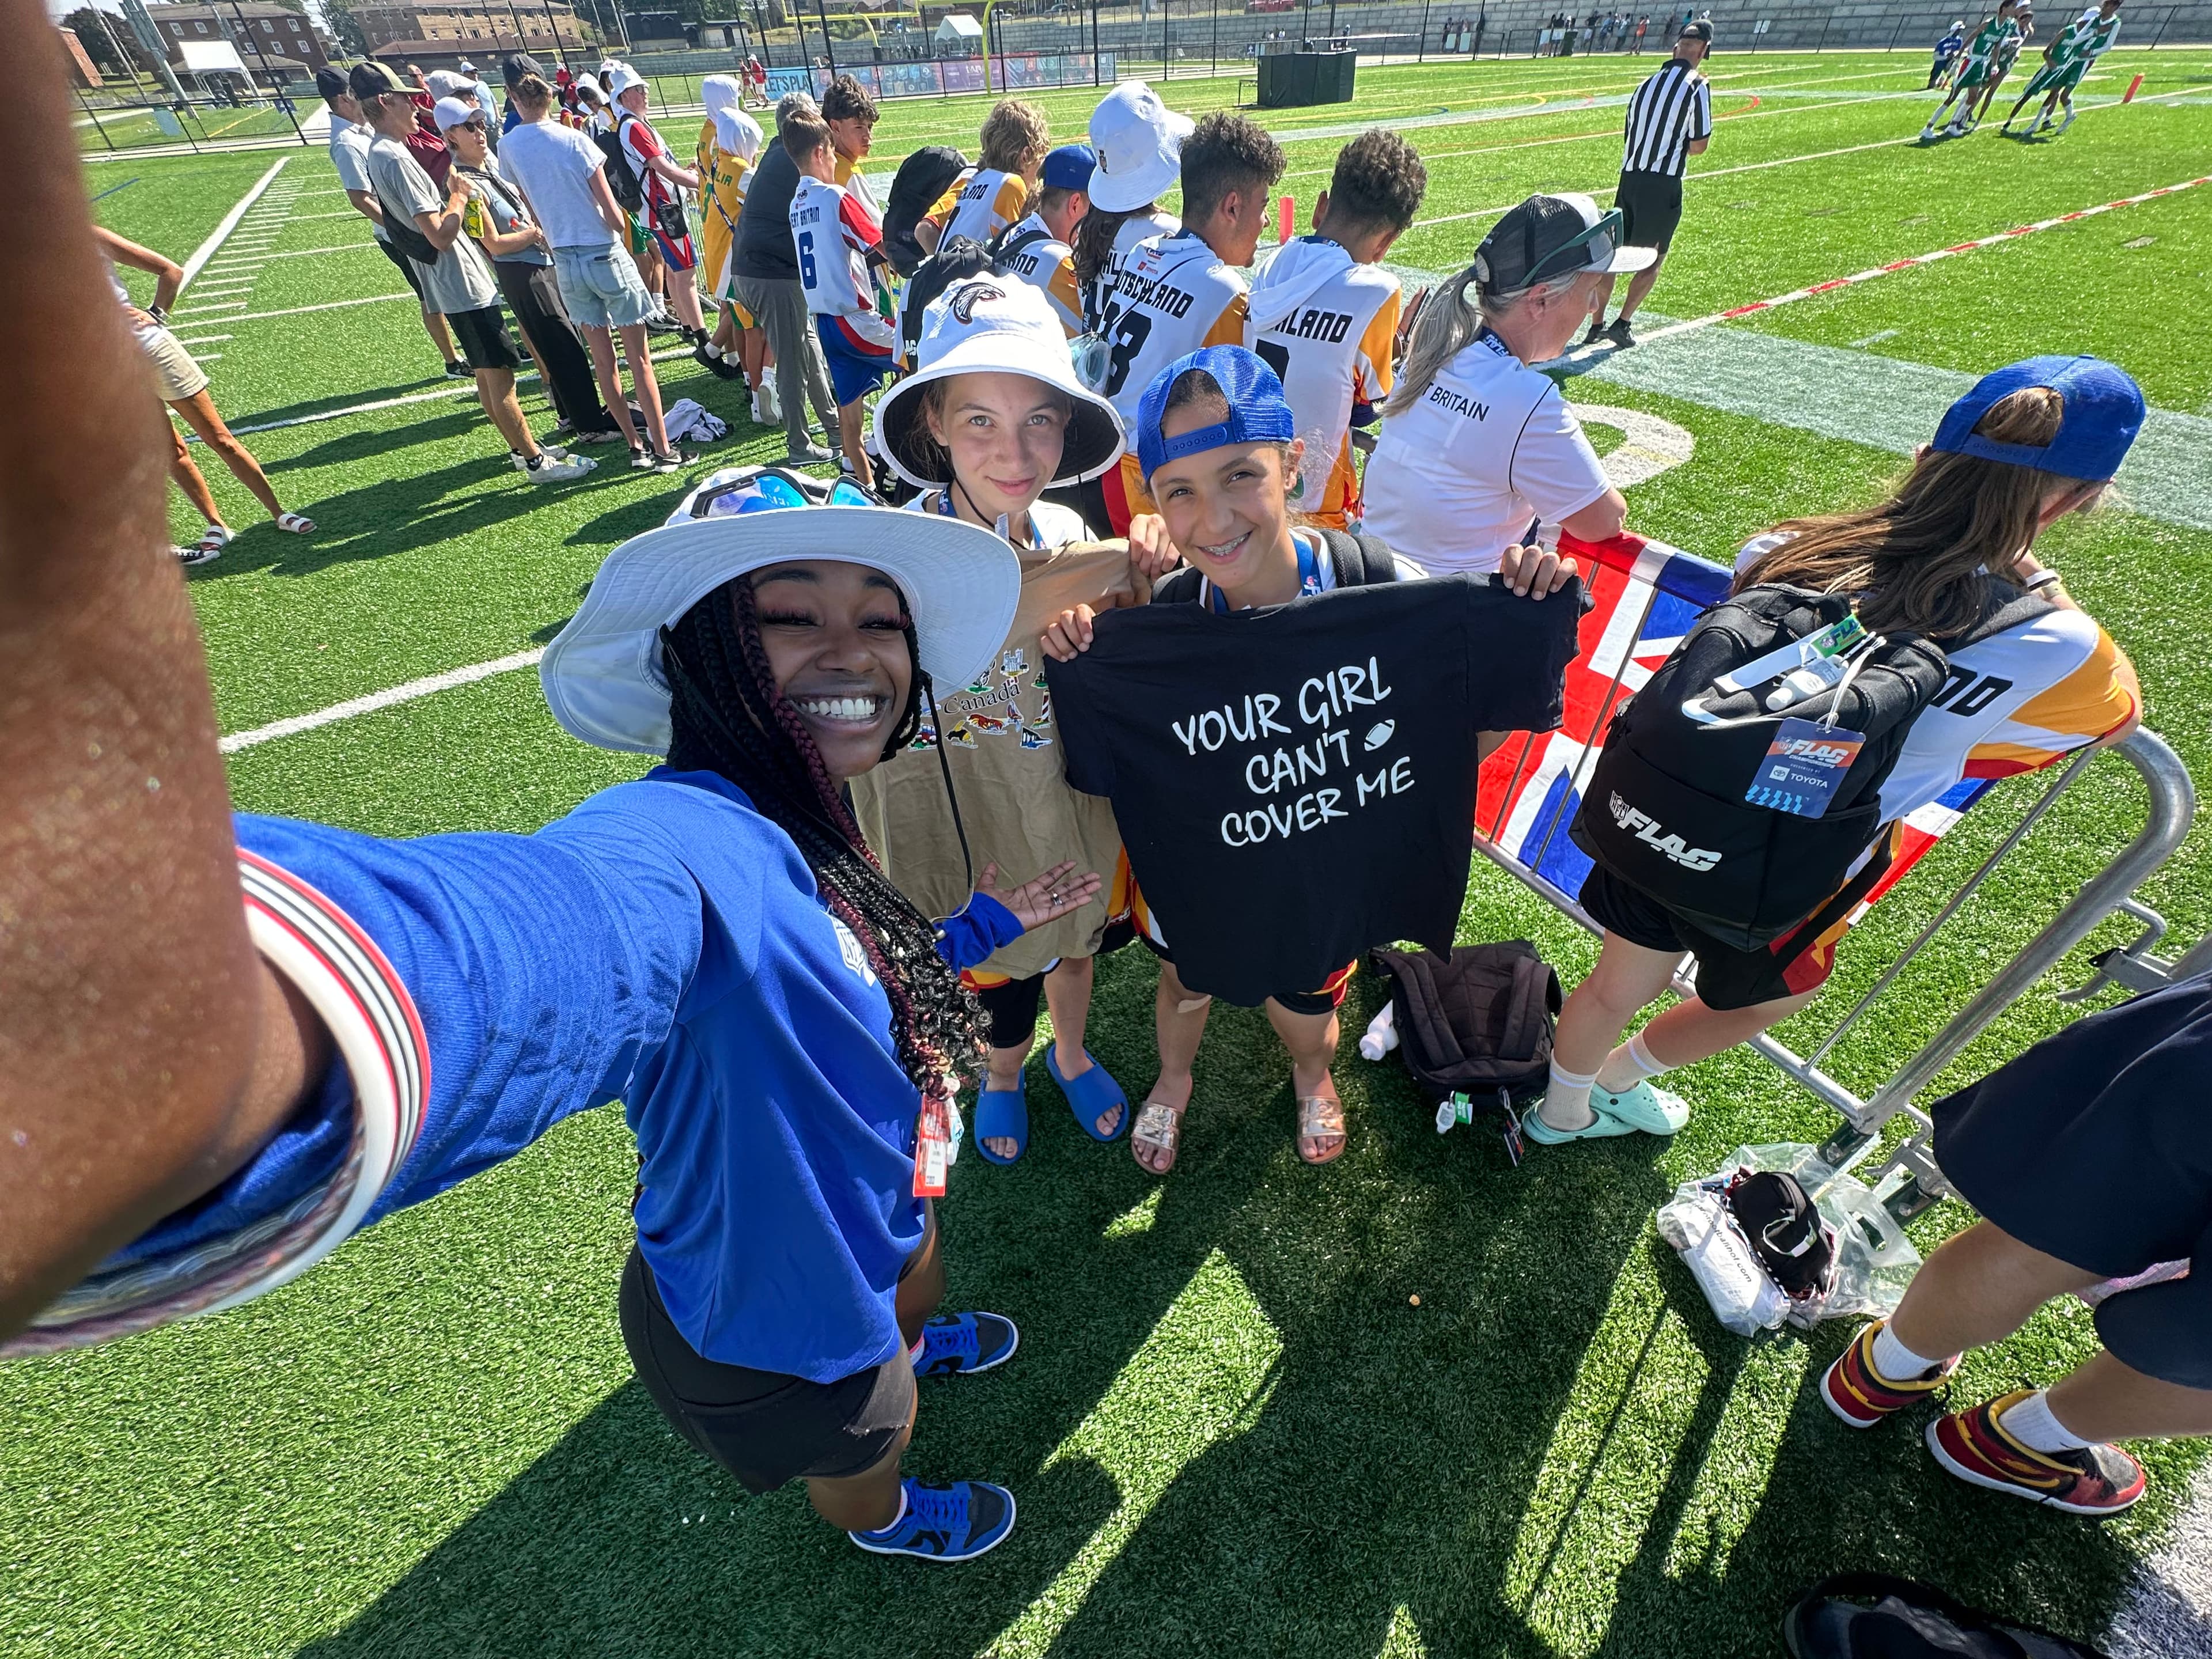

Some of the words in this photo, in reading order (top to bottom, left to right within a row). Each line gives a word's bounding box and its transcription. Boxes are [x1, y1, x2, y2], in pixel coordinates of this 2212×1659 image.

[765, 75, 790, 92] LET'S
[789, 74, 809, 91] PLA
[800, 206, 820, 226] BRITAIN
[798, 231, 818, 290] 6
[1430, 386, 1490, 422] BRITAIN
[944, 681, 1021, 714] Canada
[1172, 694, 1291, 756] YOUR
[1298, 656, 1392, 729] GIRL
[1245, 729, 1351, 794] CAN'T
[1785, 739, 1849, 764] FLAG
[1788, 754, 1836, 769] CHAMPIONSHIPS
[1790, 772, 1828, 789] TOYOTA
[1221, 789, 1349, 847] COVER
[1356, 756, 1415, 806] ME
[1617, 807, 1722, 872] FLAG
